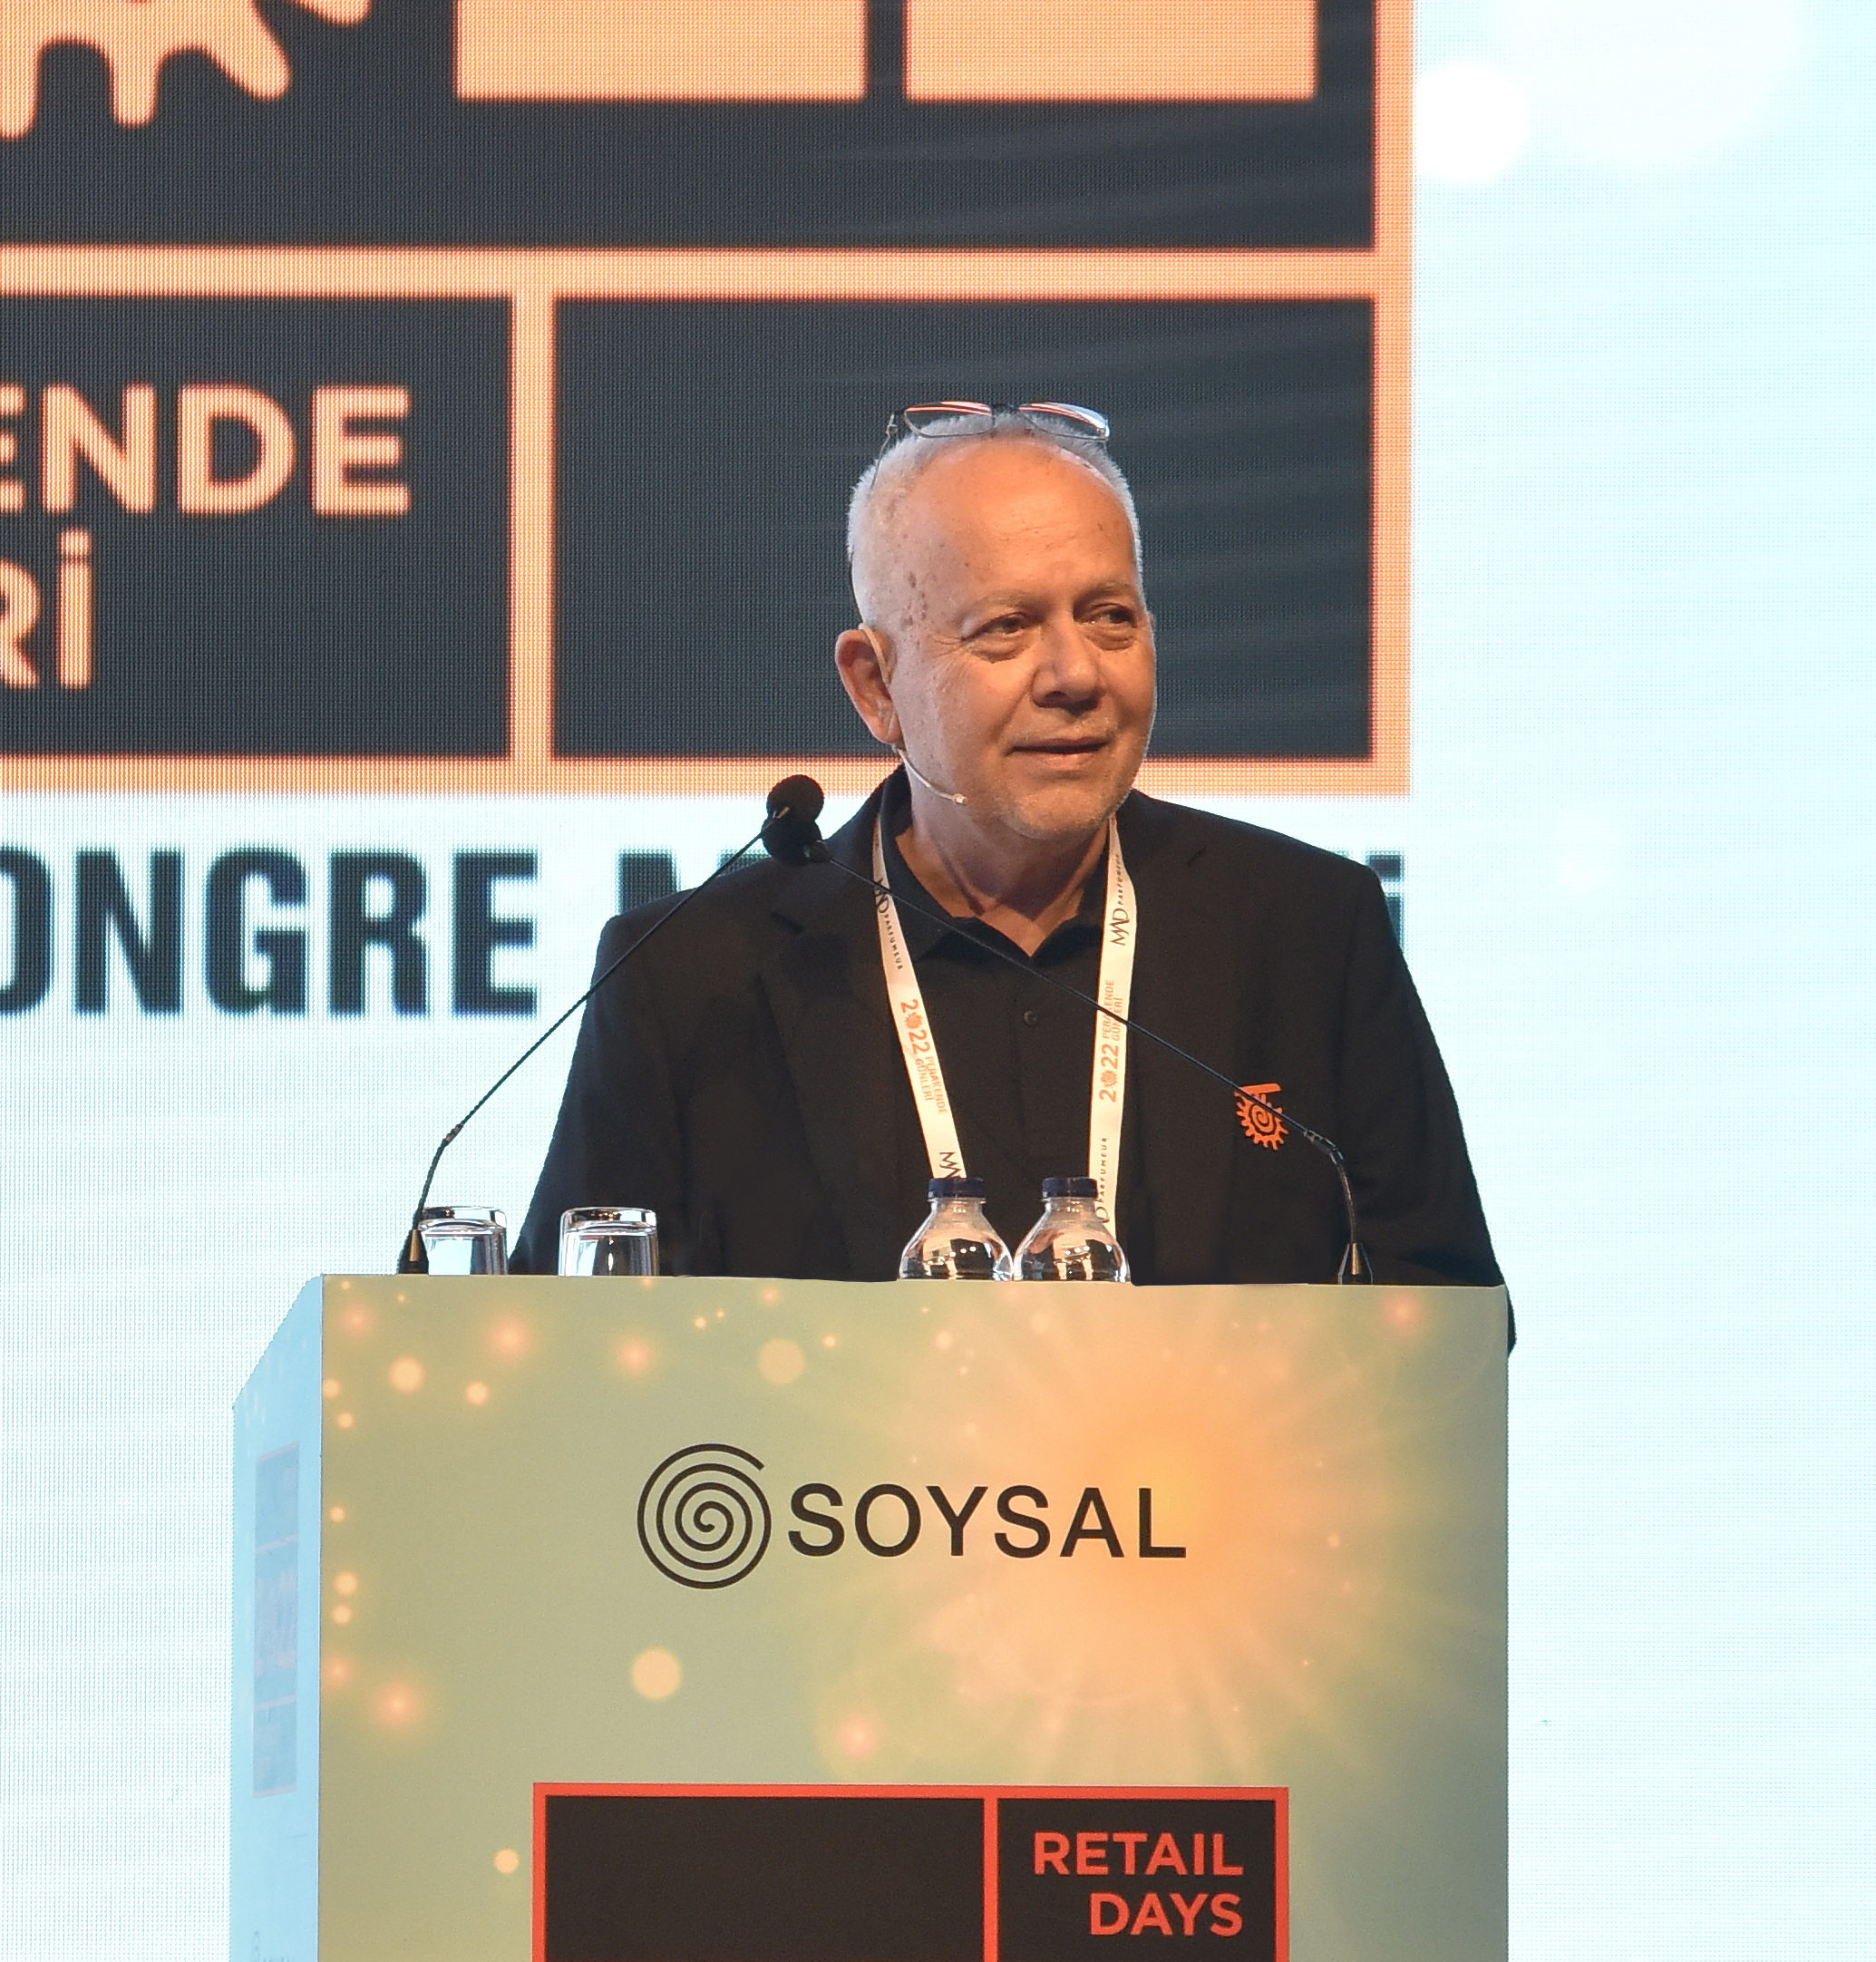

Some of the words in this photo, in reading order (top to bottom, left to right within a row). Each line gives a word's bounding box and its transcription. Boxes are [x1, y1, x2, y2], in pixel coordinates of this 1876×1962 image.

[0, 383, 413, 515] NDE
[787, 1483, 1186, 1559] SOYSAL
[1034, 1831, 1243, 1876] RETAIL
[1090, 1892, 1243, 1937] DAYS
